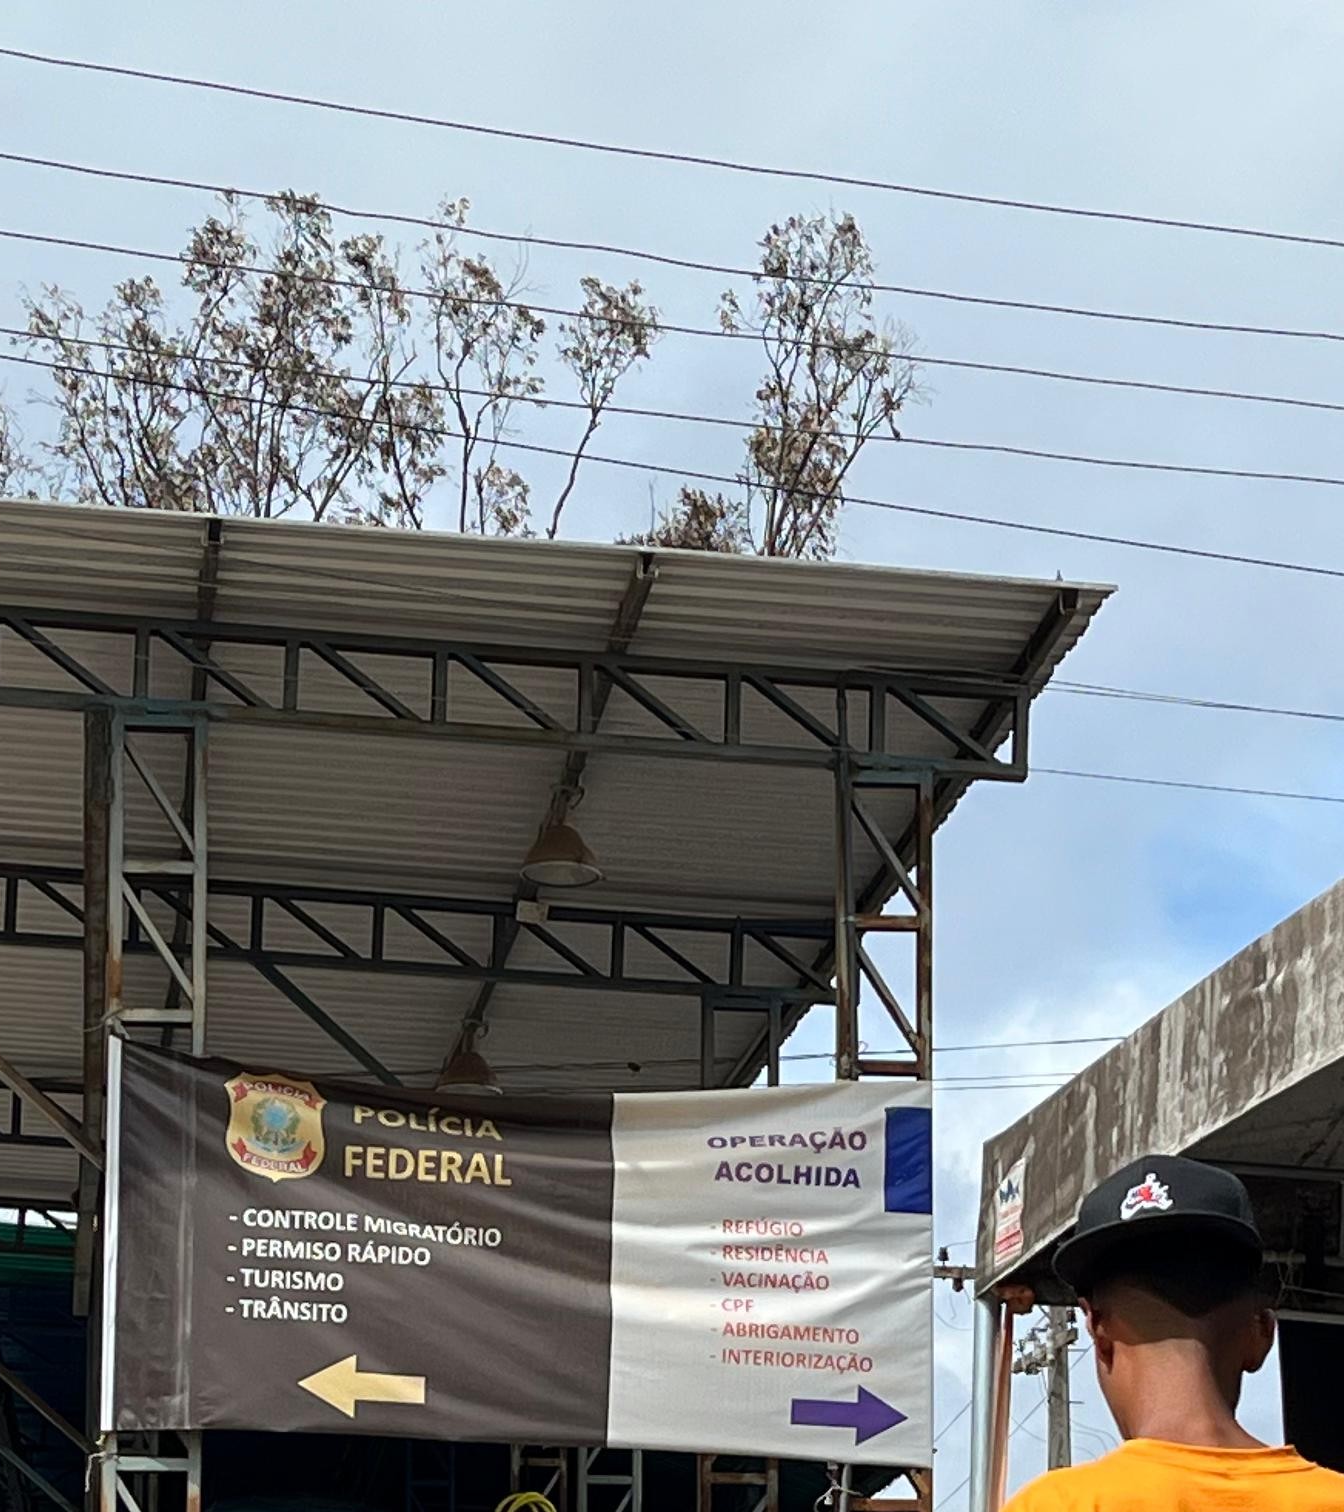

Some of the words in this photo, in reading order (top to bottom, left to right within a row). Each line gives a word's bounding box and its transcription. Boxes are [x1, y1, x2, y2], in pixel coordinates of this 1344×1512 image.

[353, 1105, 504, 1141] POLÍCIA
[707, 1127, 867, 1154] OPERAÇÃO
[243, 1152, 308, 1174] FEDERAL
[344, 1145, 513, 1187] FEDERAL
[714, 1161, 862, 1189] ACOLHIDA
[243, 1208, 359, 1232] CONTROLE
[364, 1215, 503, 1248] MIGRATÓRIO
[722, 1217, 804, 1237] REFÚGIO
[242, 1238, 341, 1262] PERMISO
[347, 1240, 431, 1266] RÁPIDO
[722, 1244, 828, 1264] RESIDÊNCIA
[240, 1268, 344, 1292] TURISMO
[721, 1271, 829, 1293] VACINAÇÃO
[239, 1296, 348, 1323] TRÂNSITO
[721, 1298, 754, 1312] CPF
[722, 1322, 860, 1345] ABRIGAMENTO
[722, 1348, 873, 1374] INTERIORIZAÇÃO
